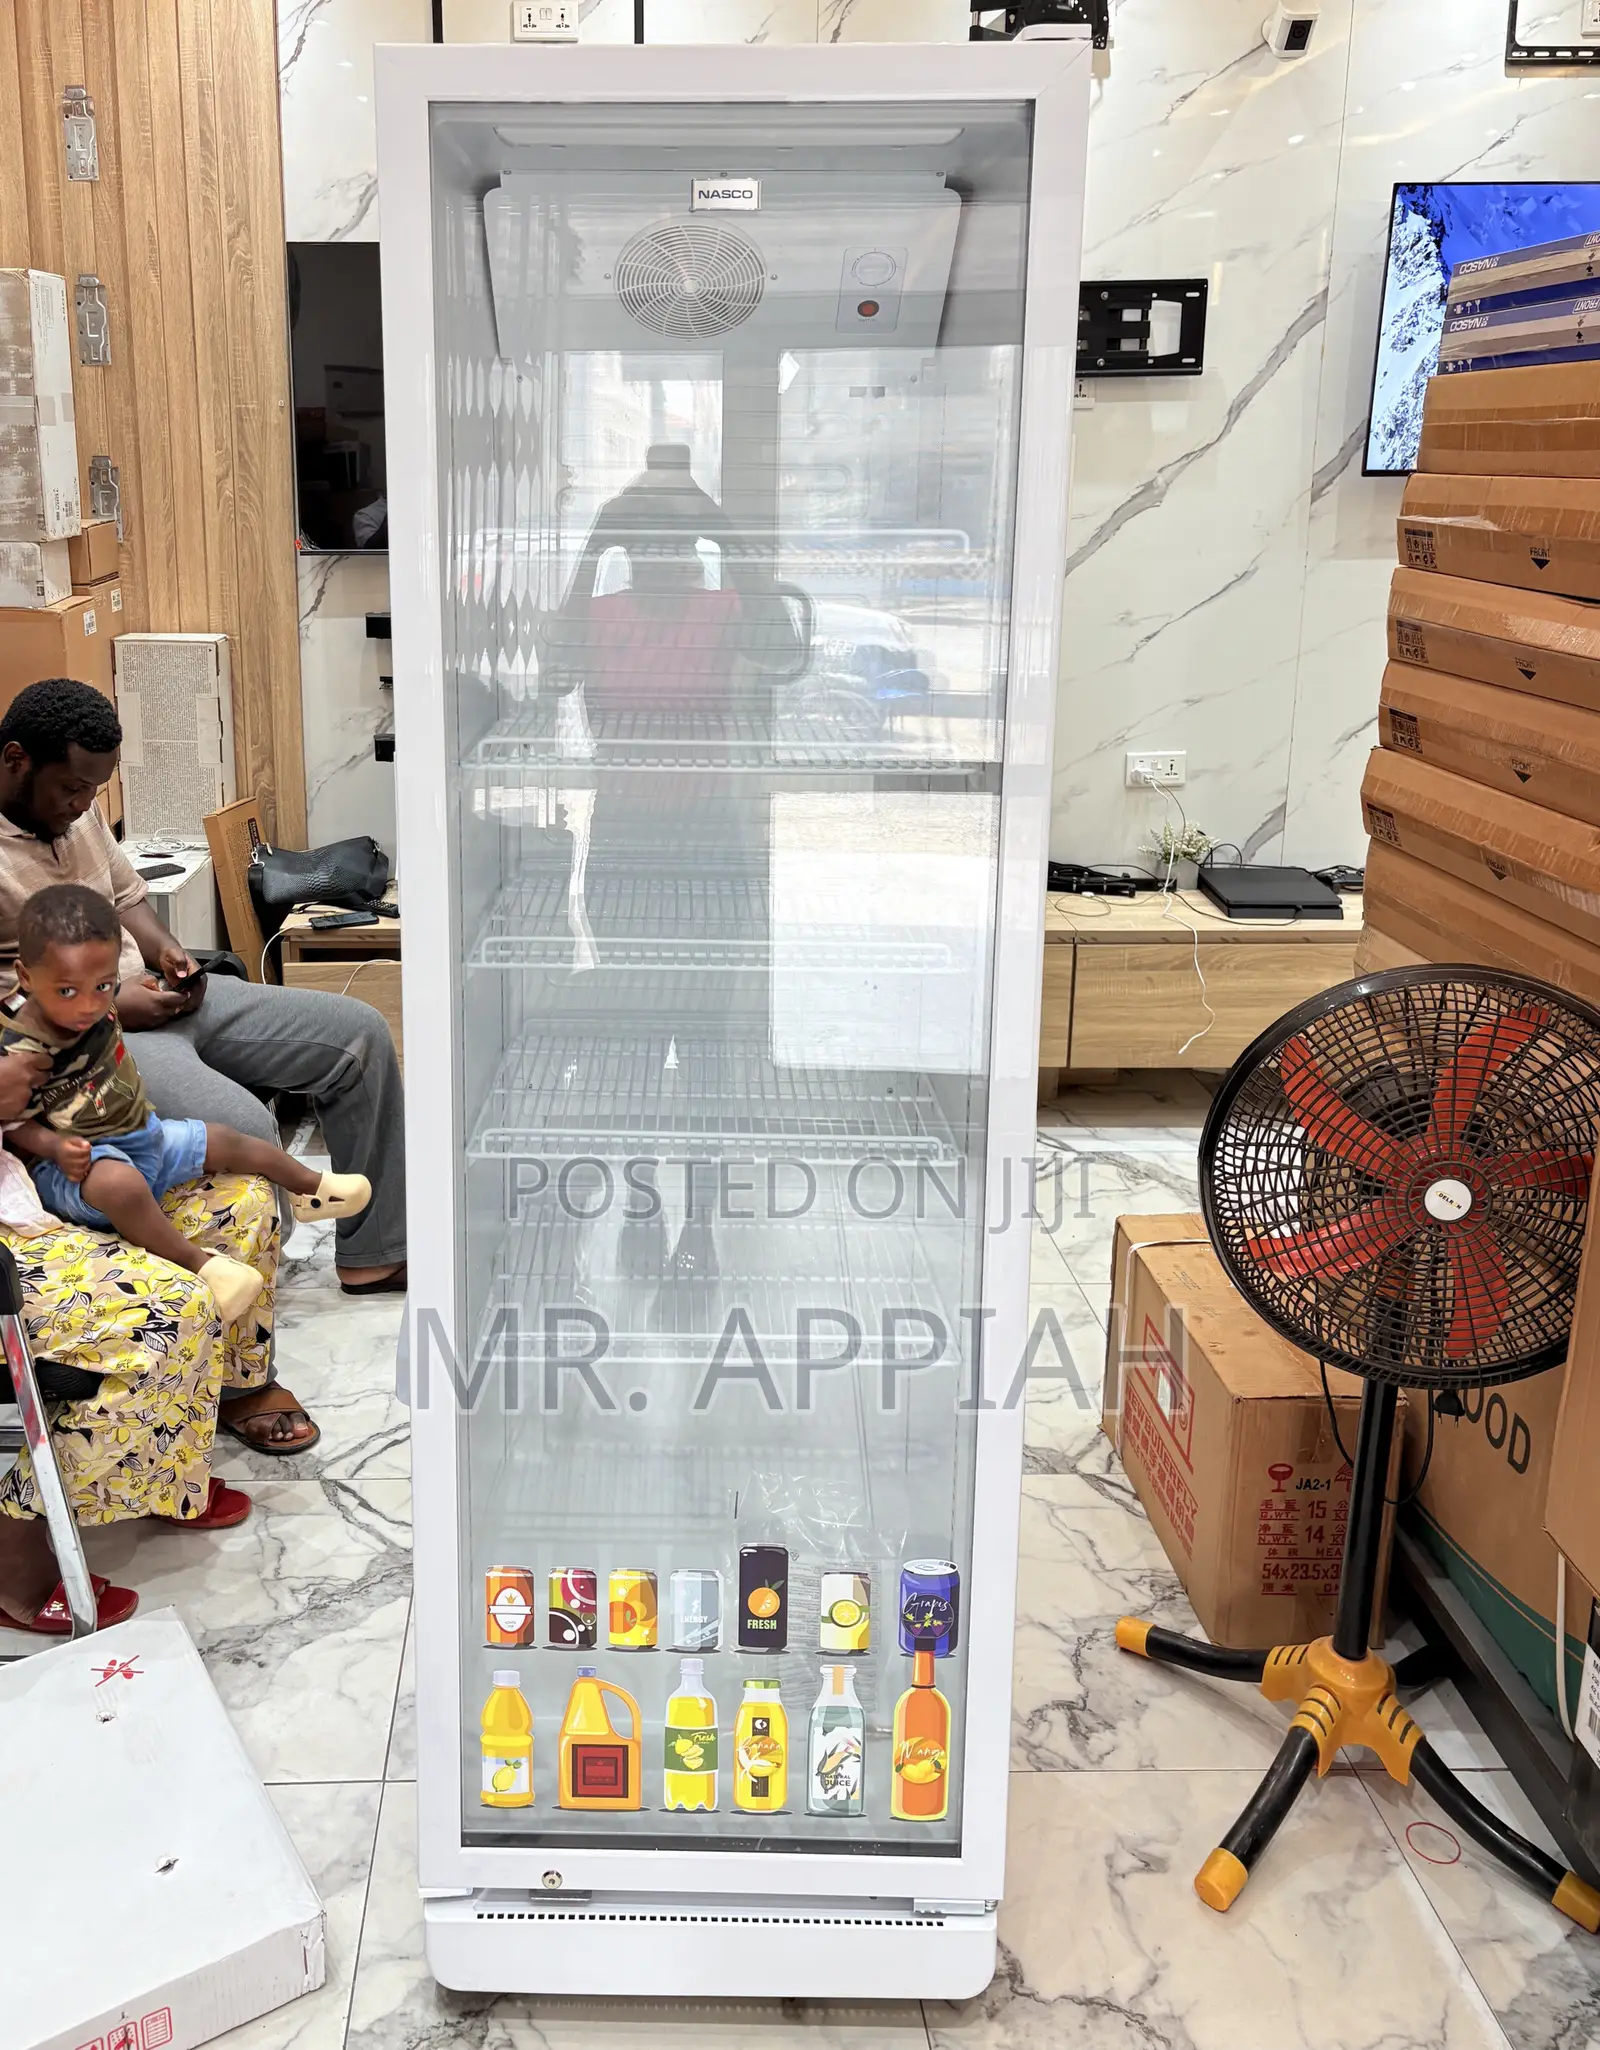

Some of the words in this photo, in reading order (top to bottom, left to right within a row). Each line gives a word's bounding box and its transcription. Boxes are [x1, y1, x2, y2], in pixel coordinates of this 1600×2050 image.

[698, 189, 753, 199] NASCO
[1459, 257, 1493, 274] NASCO
[1450, 317, 1483, 332] NASCO
[1529, 546, 1550, 558] FRONT
[1296, 1478, 1331, 1490] JA2-1
[1260, 1511, 1294, 1519] G.WT.
[1308, 1500, 1327, 1519] 15
[1258, 1535, 1292, 1543] N.WT.
[1305, 1525, 1325, 1543] 14
[747, 1619, 777, 1630] FRESH
[691, 1731, 716, 1742] Fresh
